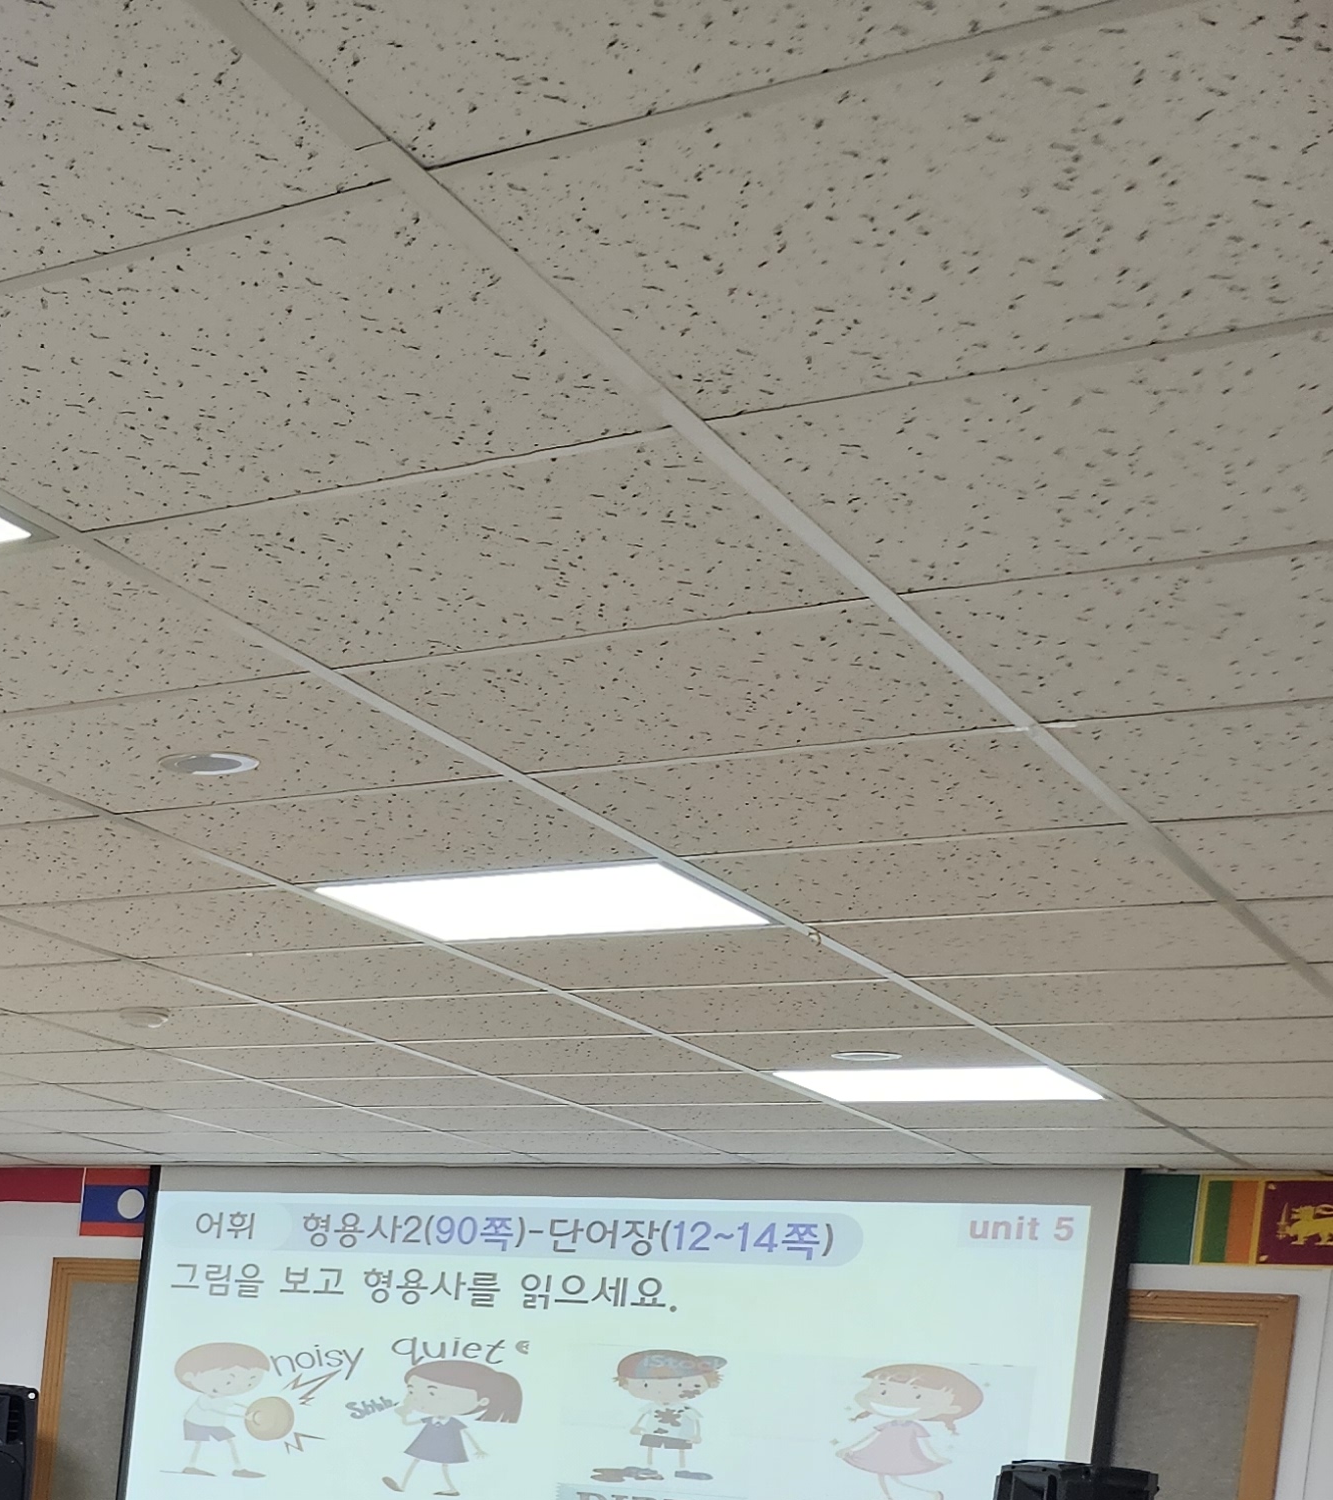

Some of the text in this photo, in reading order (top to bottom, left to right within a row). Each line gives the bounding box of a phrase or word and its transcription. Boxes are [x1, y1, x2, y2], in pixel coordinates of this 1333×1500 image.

[195, 1211, 256, 1240] 어휘
[969, 1215, 1075, 1241] unit 5
[170, 1262, 678, 1313] 그림을 보고 형용사를 읽으세요.
[270, 1344, 364, 1380] noisy
[391, 1336, 506, 1366] quiet
